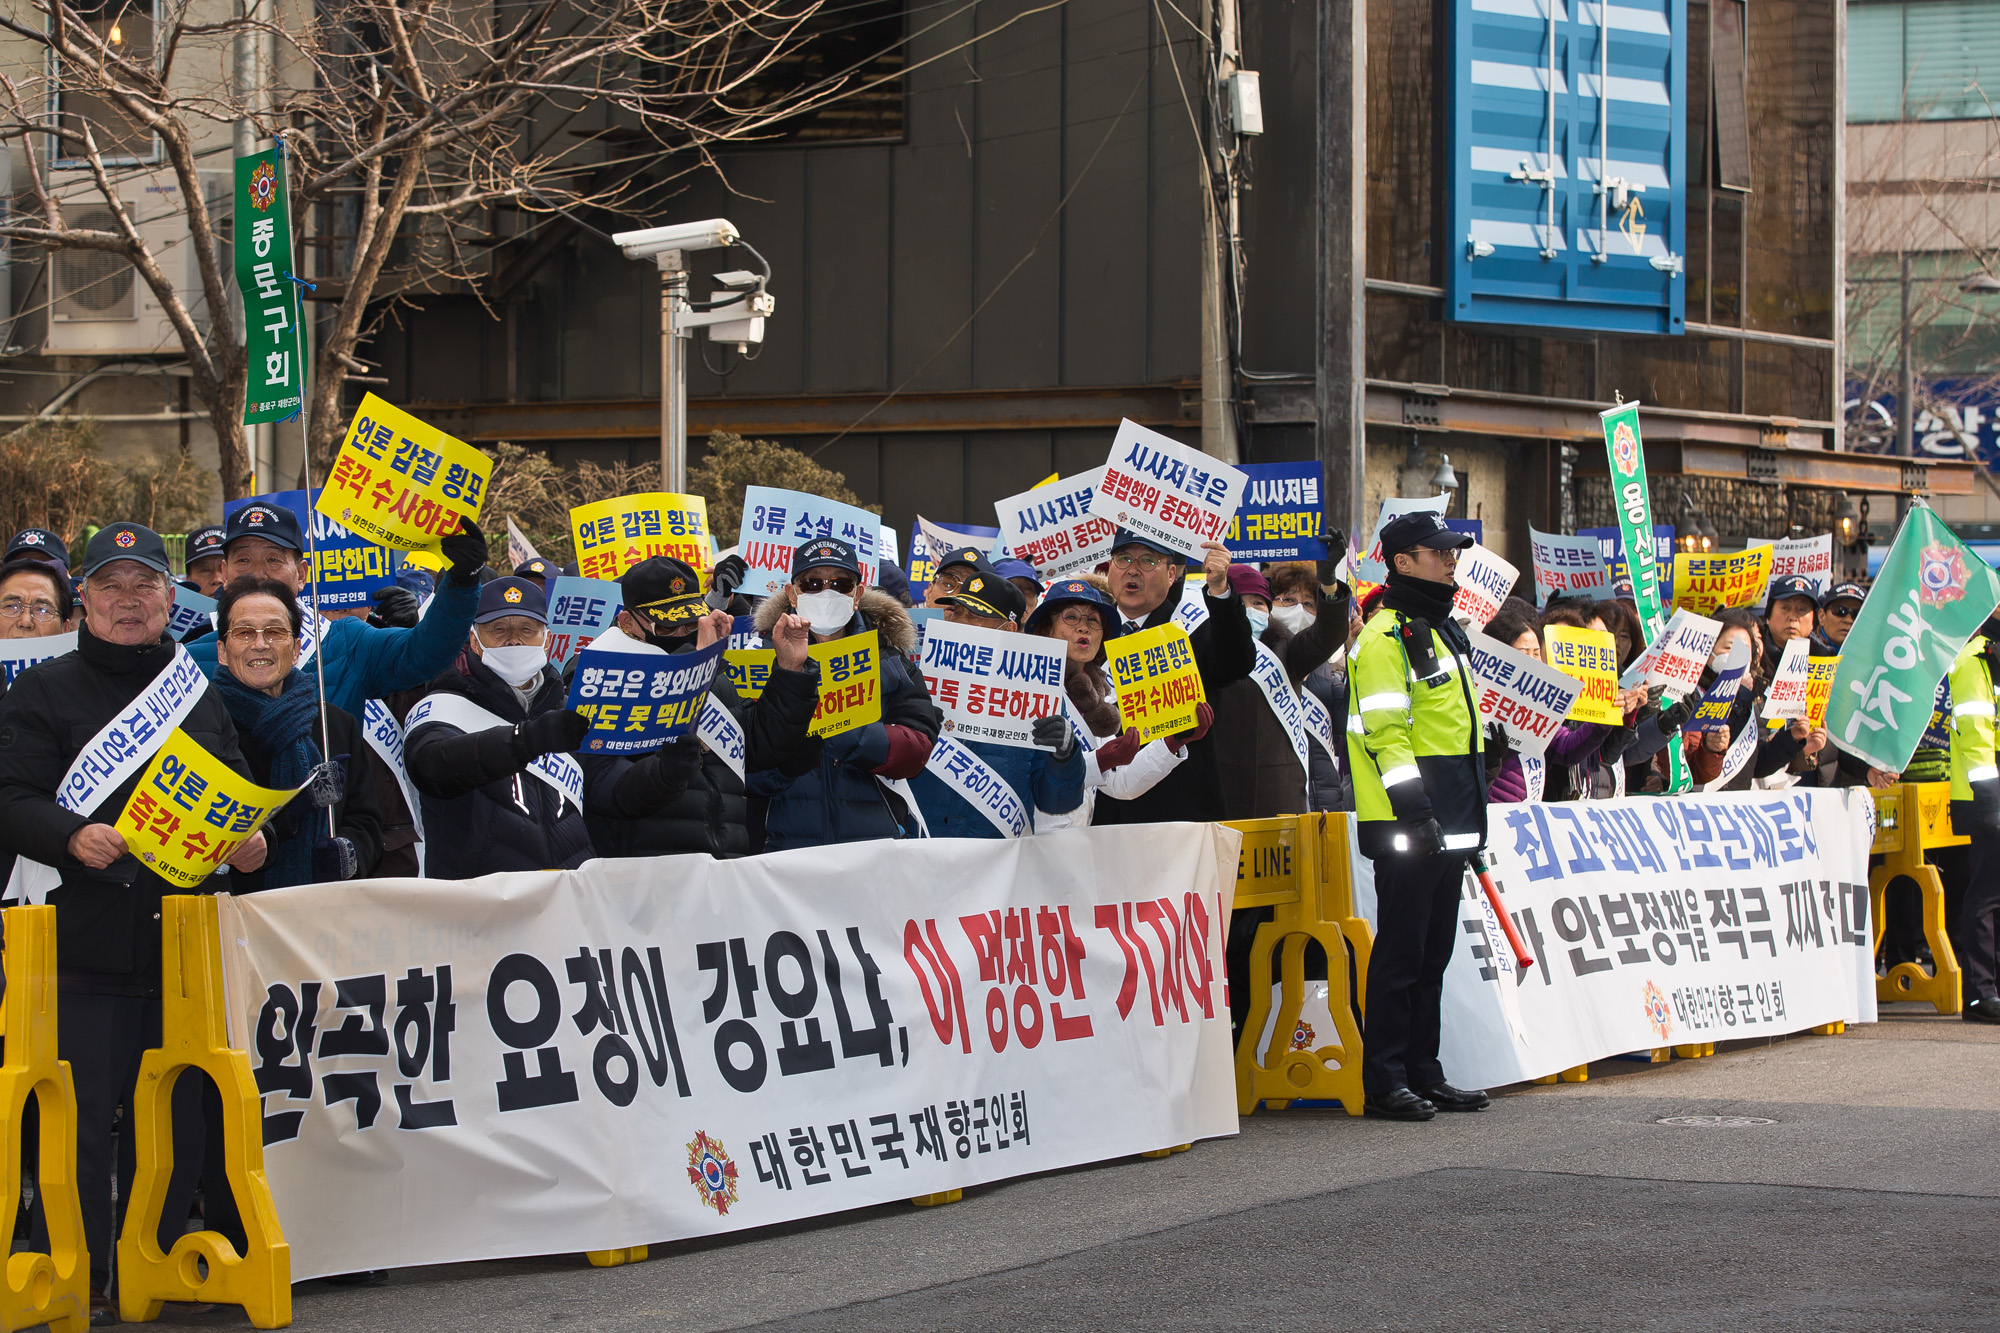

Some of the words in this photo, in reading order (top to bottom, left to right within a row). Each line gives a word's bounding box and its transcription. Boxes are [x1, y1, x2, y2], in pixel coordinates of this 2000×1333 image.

[251, 217, 290, 388] 종로구회
[259, 399, 278, 412] 종로구
[277, 396, 300, 409] 재향군인
[1913, 404, 2000, 456] 쌍
[350, 415, 395, 462] 언론
[389, 436, 444, 487] 갑질
[441, 462, 485, 508] 횡포
[1124, 442, 1229, 508] 시사저널은
[332, 454, 373, 500] 즉각
[370, 478, 471, 538] 수사하라
[1016, 484, 1099, 534] 시사저널
[1100, 467, 1162, 516] 불법행위
[1158, 493, 1229, 543] 중단하라!
[1249, 476, 1319, 508] 시사저널
[352, 514, 430, 550] 대한민국재향군인회
[578, 515, 616, 551] 언론
[621, 512, 662, 539] 갑질
[666, 509, 705, 536] 횡포
[752, 505, 787, 536] 3류
[794, 511, 834, 540] 소설
[1071, 517, 1118, 549] 중단하
[1129, 516, 1193, 551] 대한민국재향군인회
[1246, 511, 1322, 541] 규탄한다!
[582, 551, 619, 580] 즉각
[743, 540, 795, 575] 시사저
[1058, 547, 1113, 573] 대한민국재향군인
[1553, 546, 1597, 567] 모르는
[1688, 552, 1763, 577] 본분망각
[1543, 569, 1568, 592] 즉각
[1686, 569, 1760, 594] 시사저널
[552, 595, 607, 628] 한글도
[1677, 596, 1718, 611] 즉각
[578, 667, 646, 699] 향군은
[649, 653, 720, 699] 청와대와
[725, 664, 769, 690] 언론
[829, 647, 872, 682] 횡포
[924, 637, 994, 677] 가짜언론
[996, 649, 1063, 687] 시사저널
[1115, 653, 1144, 686] 언론
[1143, 644, 1170, 678] 갑질
[1166, 638, 1192, 670] 횡포
[1551, 641, 1575, 666] 언론
[1577, 642, 1597, 669] 갑질
[1599, 646, 1616, 672] 횡포
[1653, 651, 1693, 681] 불법행위
[1121, 689, 1148, 722] 즉각
[1149, 673, 1201, 715] 수사하라!
[1470, 646, 1517, 688] 짜언론
[1511, 671, 1574, 715] 시사저널
[1806, 681, 1833, 700] 사저
[624, 705, 652, 733] 못
[655, 690, 708, 730] 먹냐?
[966, 682, 1060, 721] 중단하자!
[1478, 688, 1559, 739] 중단하자!
[957, 722, 1029, 742] 대한민국재향군인회
[1151, 714, 1192, 735] 대한민국재향군인회
[152, 753, 209, 813] 언론
[204, 790, 264, 834] 갑질
[128, 789, 182, 847] 즉각
[1253, 845, 1291, 879] LINE
[1551, 887, 1711, 978] 안보정책을
[1703, 886, 1779, 961] 적극
[1671, 979, 1787, 1032] 대한민국향군인회
[253, 963, 459, 1149] 완곡한
[485, 945, 694, 1113] 요청이
[902, 917, 973, 1056] 이
[957, 904, 1095, 1055] 멍청한
[748, 1089, 1032, 1192] 대한민국재향군인회
